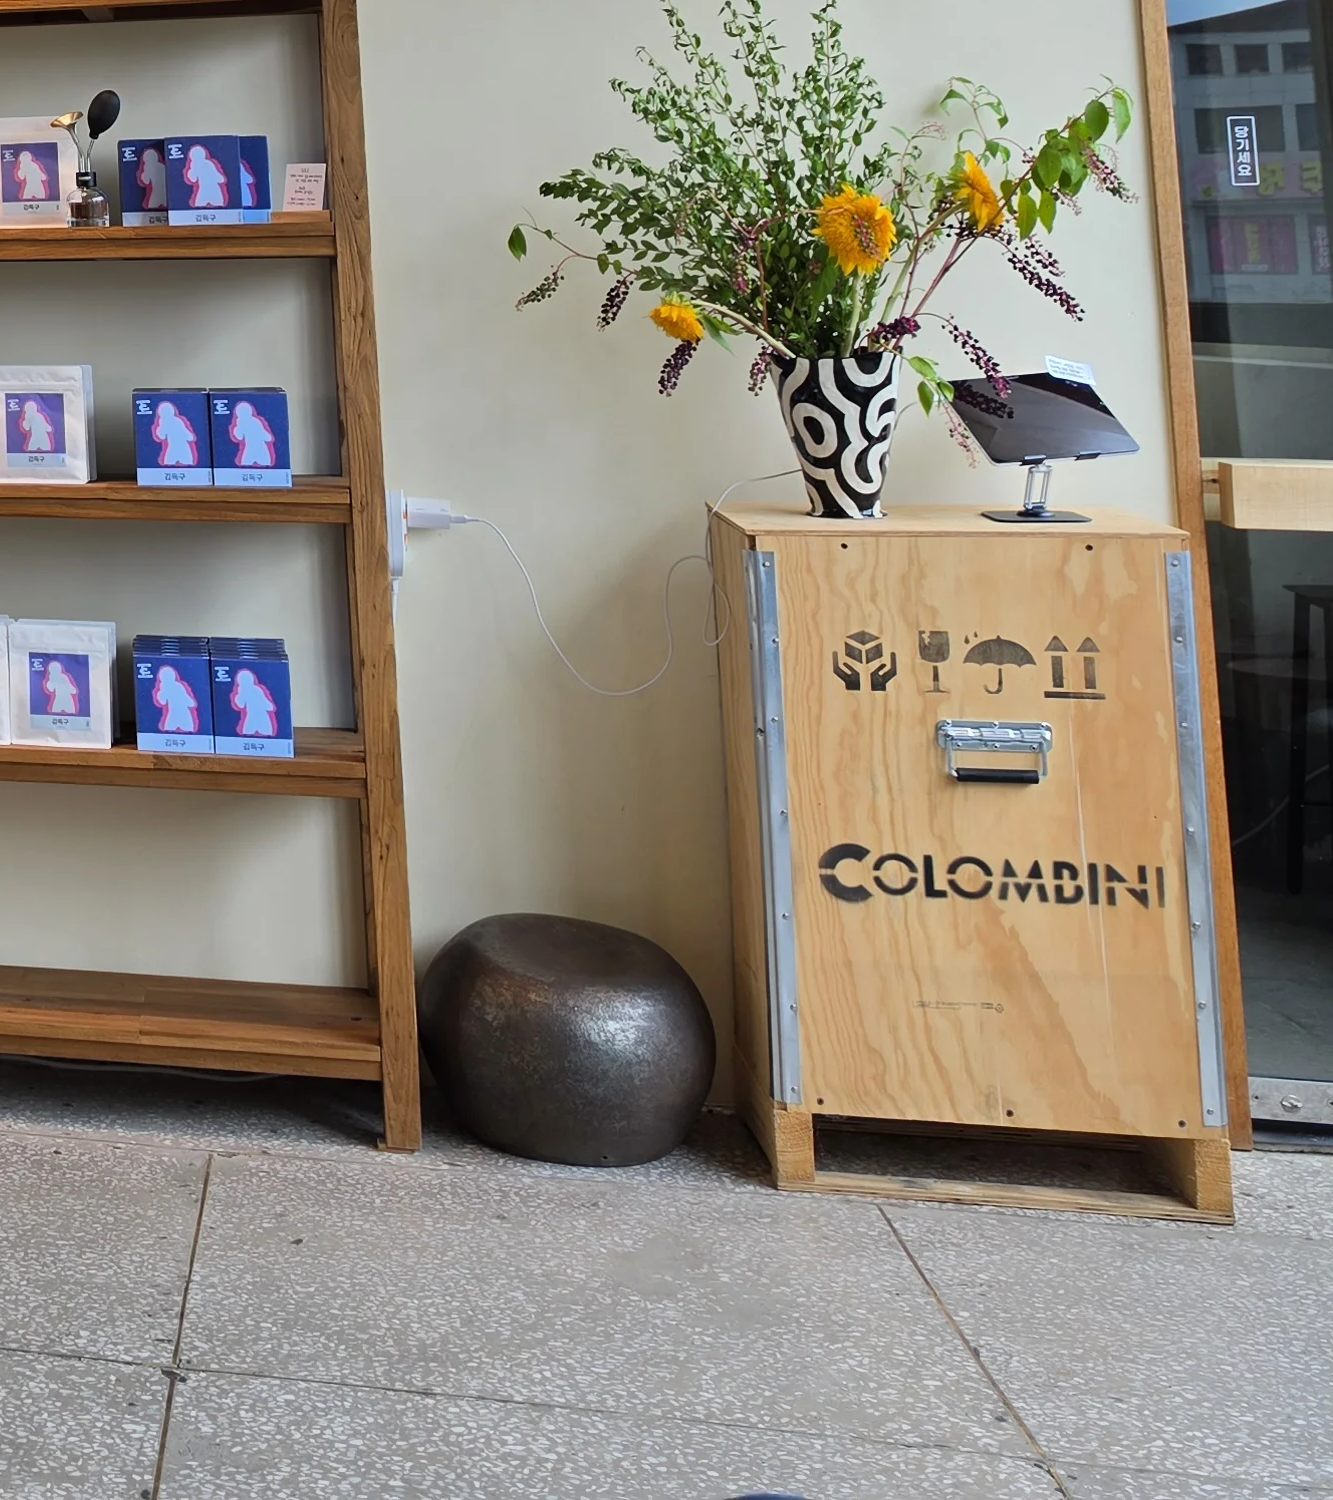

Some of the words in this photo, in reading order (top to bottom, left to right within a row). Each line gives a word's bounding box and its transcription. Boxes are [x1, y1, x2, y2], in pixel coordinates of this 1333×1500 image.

[1234, 125, 1253, 177] 당기세요
[164, 472, 186, 481] 김득구
[241, 473, 263, 482] 김득구
[164, 738, 186, 747] 김득구
[242, 742, 265, 751] 김득구
[817, 843, 1167, 910] COLOMBINI
